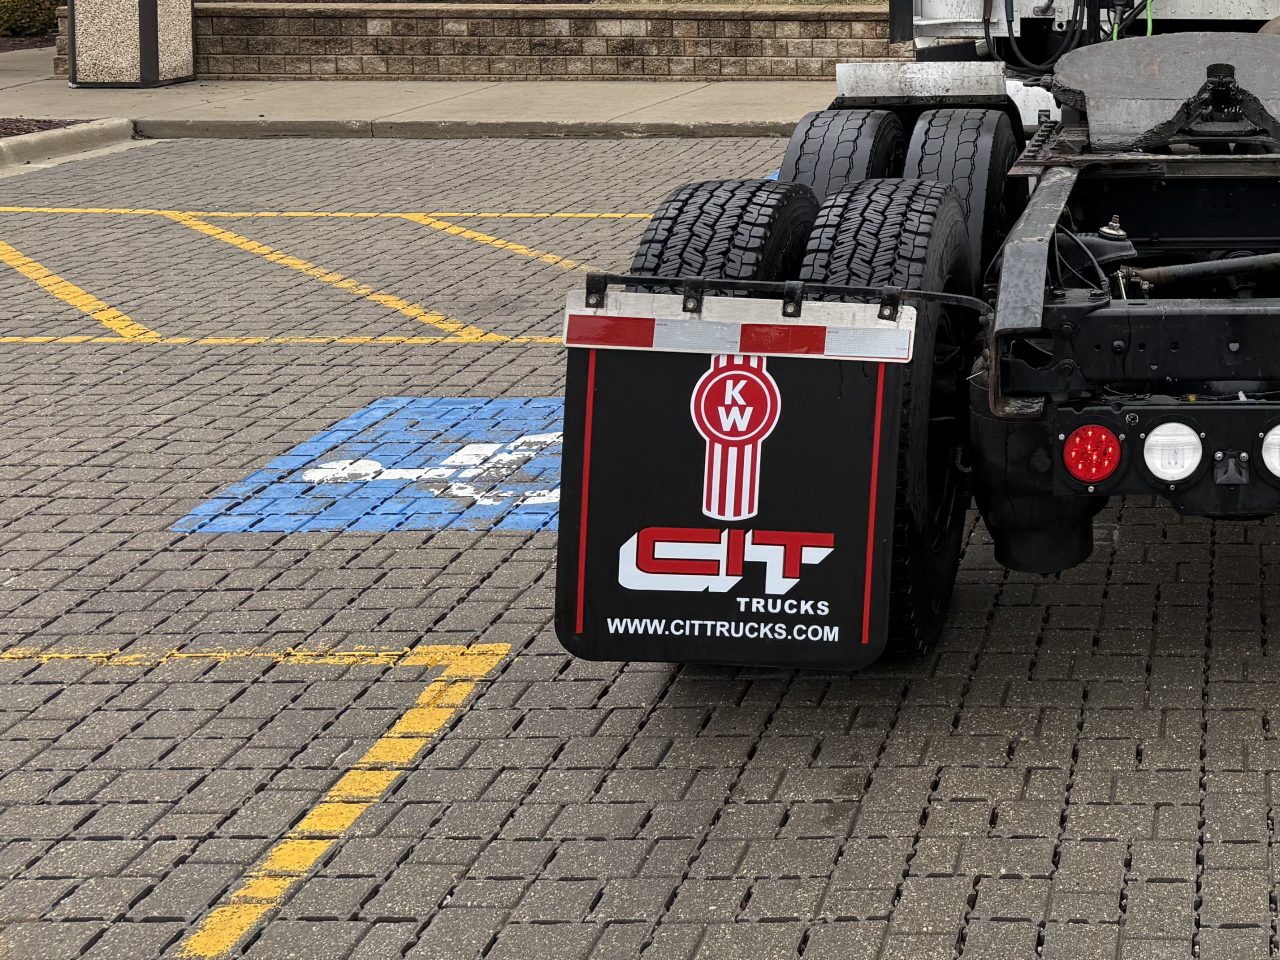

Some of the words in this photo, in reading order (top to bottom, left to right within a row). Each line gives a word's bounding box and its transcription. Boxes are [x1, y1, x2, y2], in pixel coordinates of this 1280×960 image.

[725, 379, 747, 406] K
[717, 406, 754, 432] W
[618, 527, 835, 595] CIT
[736, 597, 830, 616] TRUCKS
[606, 617, 840, 643] WWW.CITTRUCKS.COM
